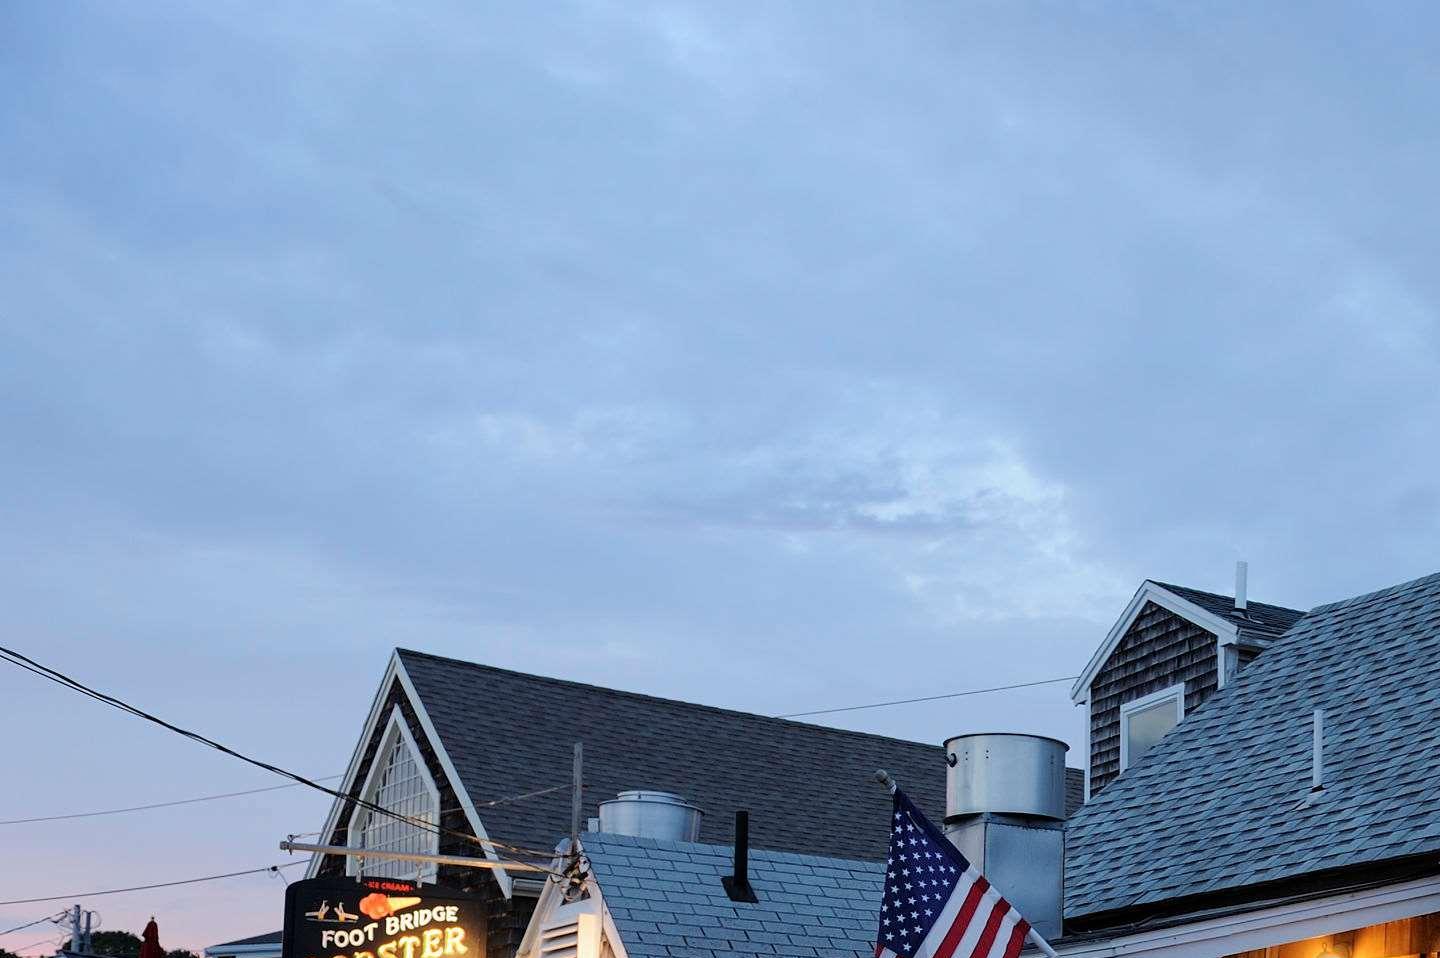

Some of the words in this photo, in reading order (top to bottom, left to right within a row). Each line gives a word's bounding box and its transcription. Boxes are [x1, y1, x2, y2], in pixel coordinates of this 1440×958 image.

[368, 881, 380, 890] ICE
[381, 881, 410, 892] CREAM
[322, 922, 378, 948] FOOT
[386, 906, 459, 936] BRIDGE
